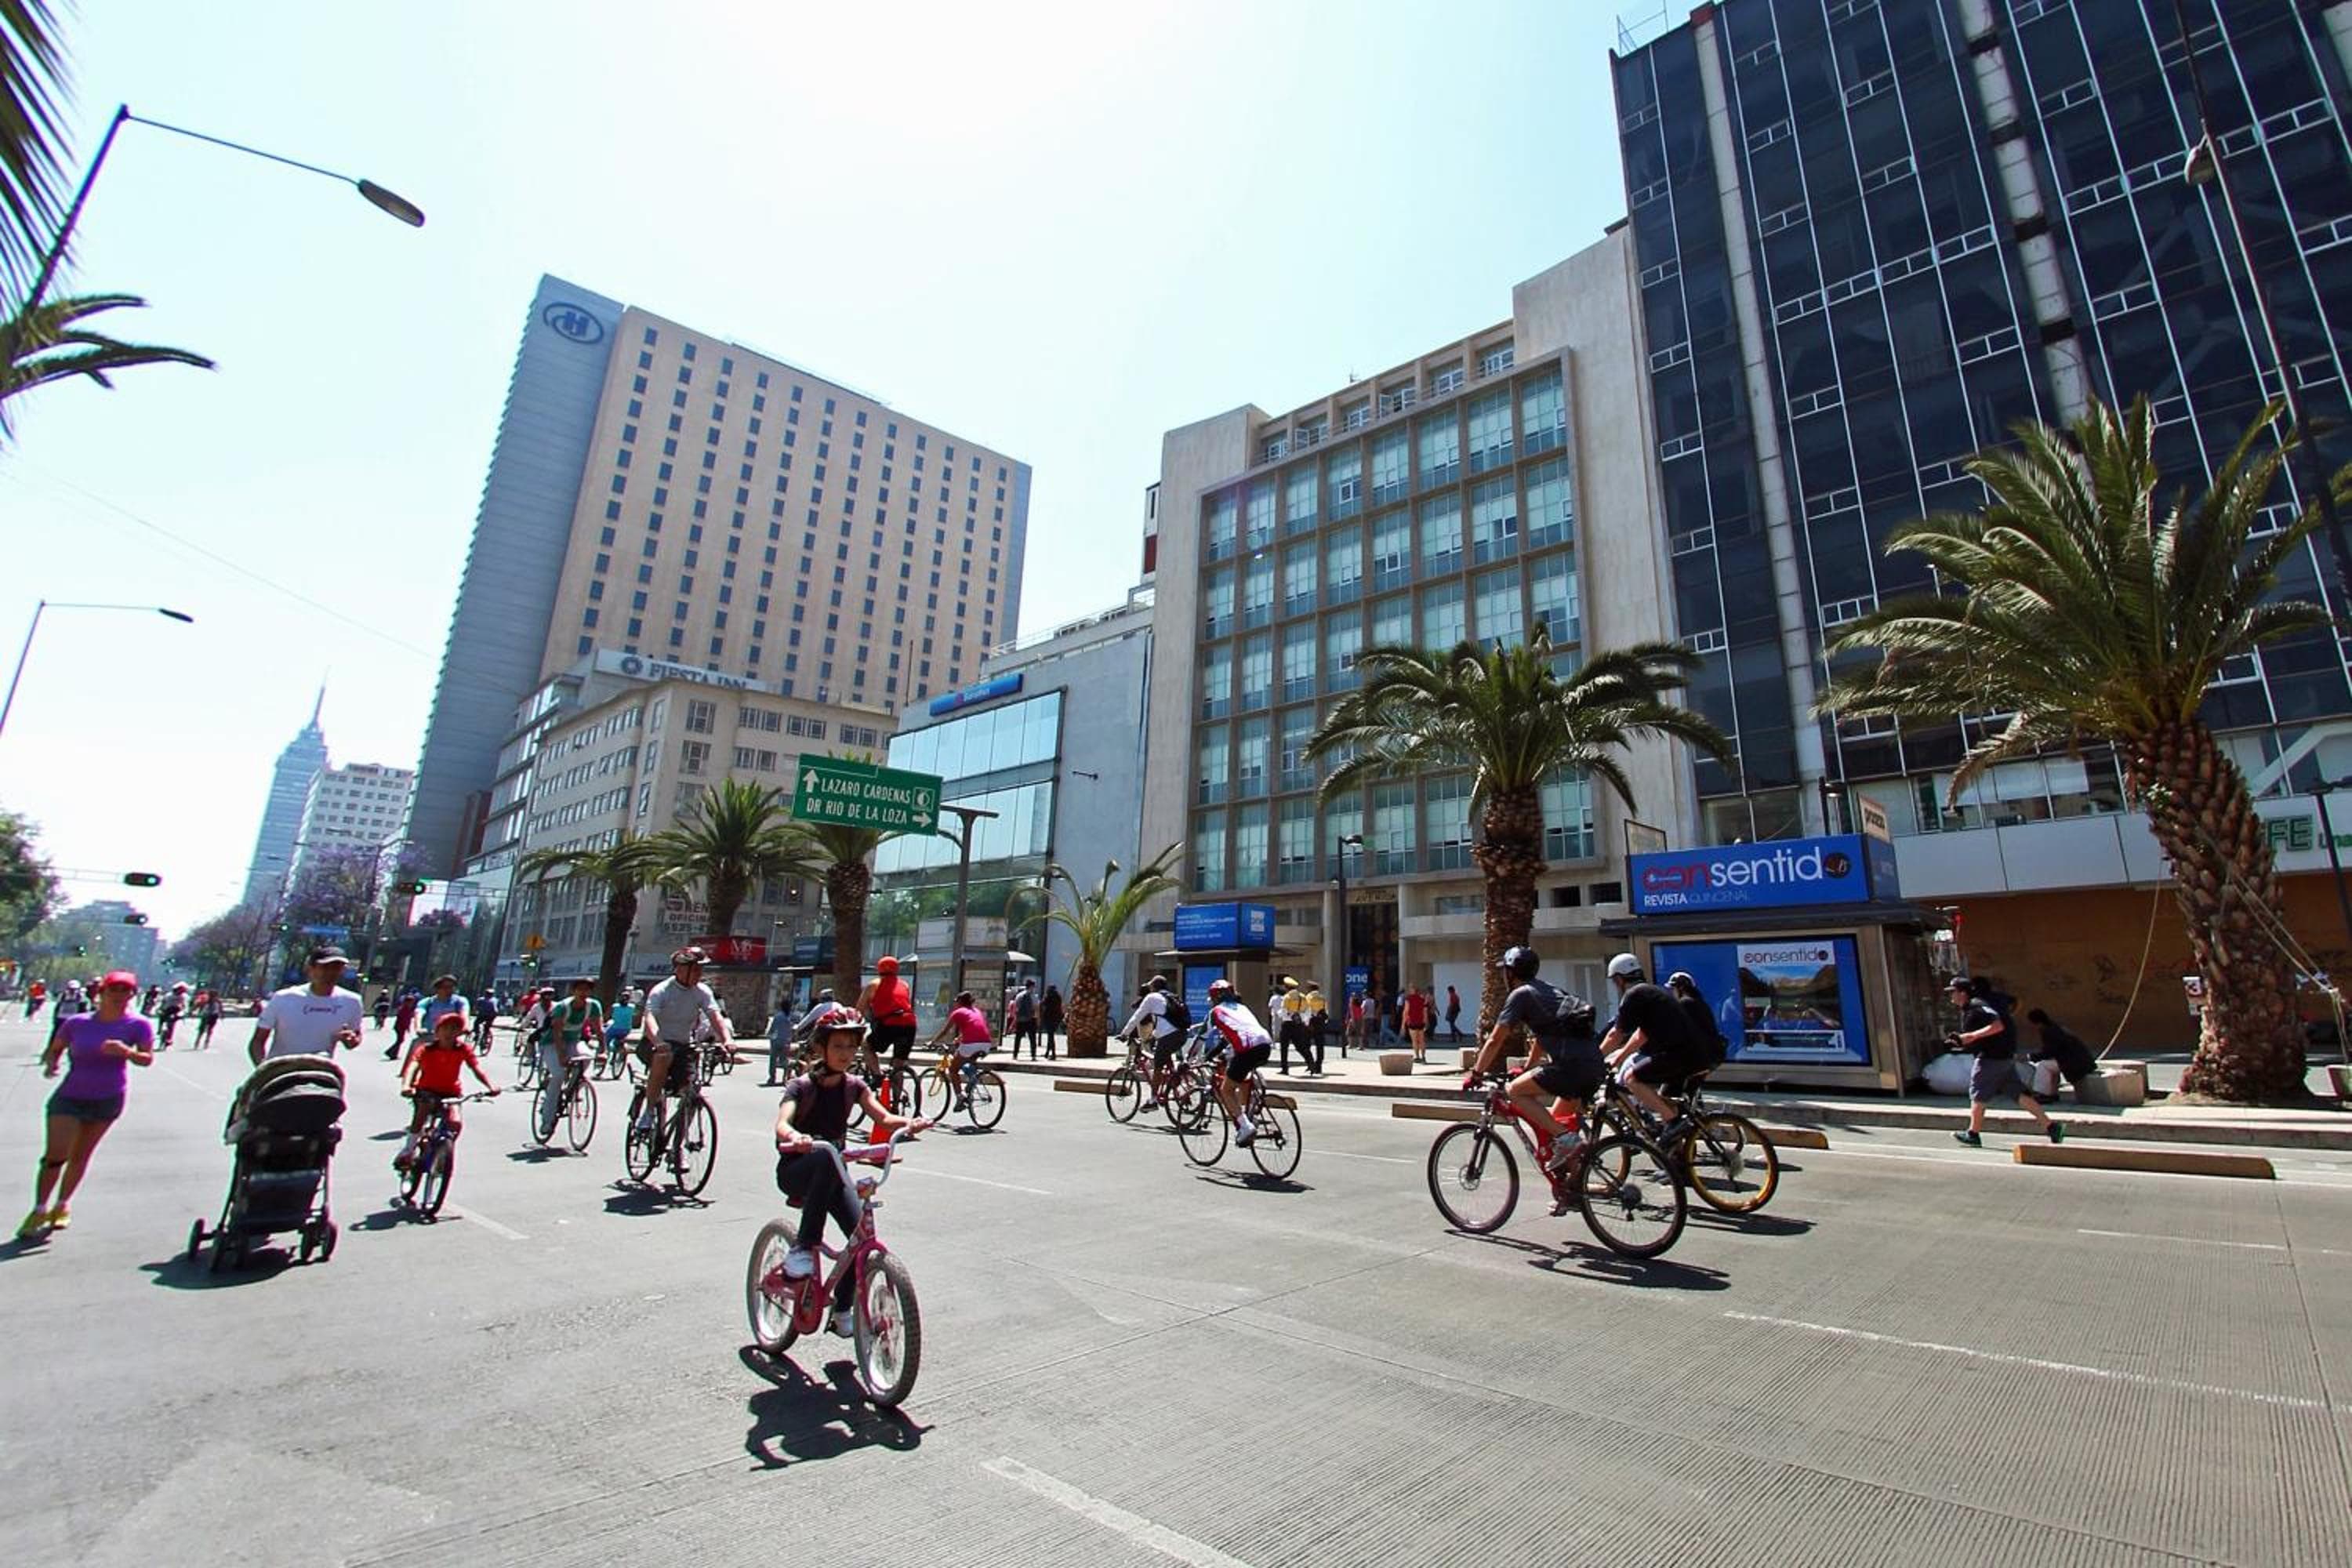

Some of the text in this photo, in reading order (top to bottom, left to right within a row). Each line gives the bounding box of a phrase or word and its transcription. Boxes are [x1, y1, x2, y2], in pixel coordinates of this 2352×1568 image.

[822, 778, 910, 804] LAZARO CARDENAS
[806, 797, 907, 824] DR RIO DE LA LOZA
[2263, 814, 2312, 852] FE
[1644, 893, 1688, 907] REVISTA
[1744, 944, 1828, 964] consentido
